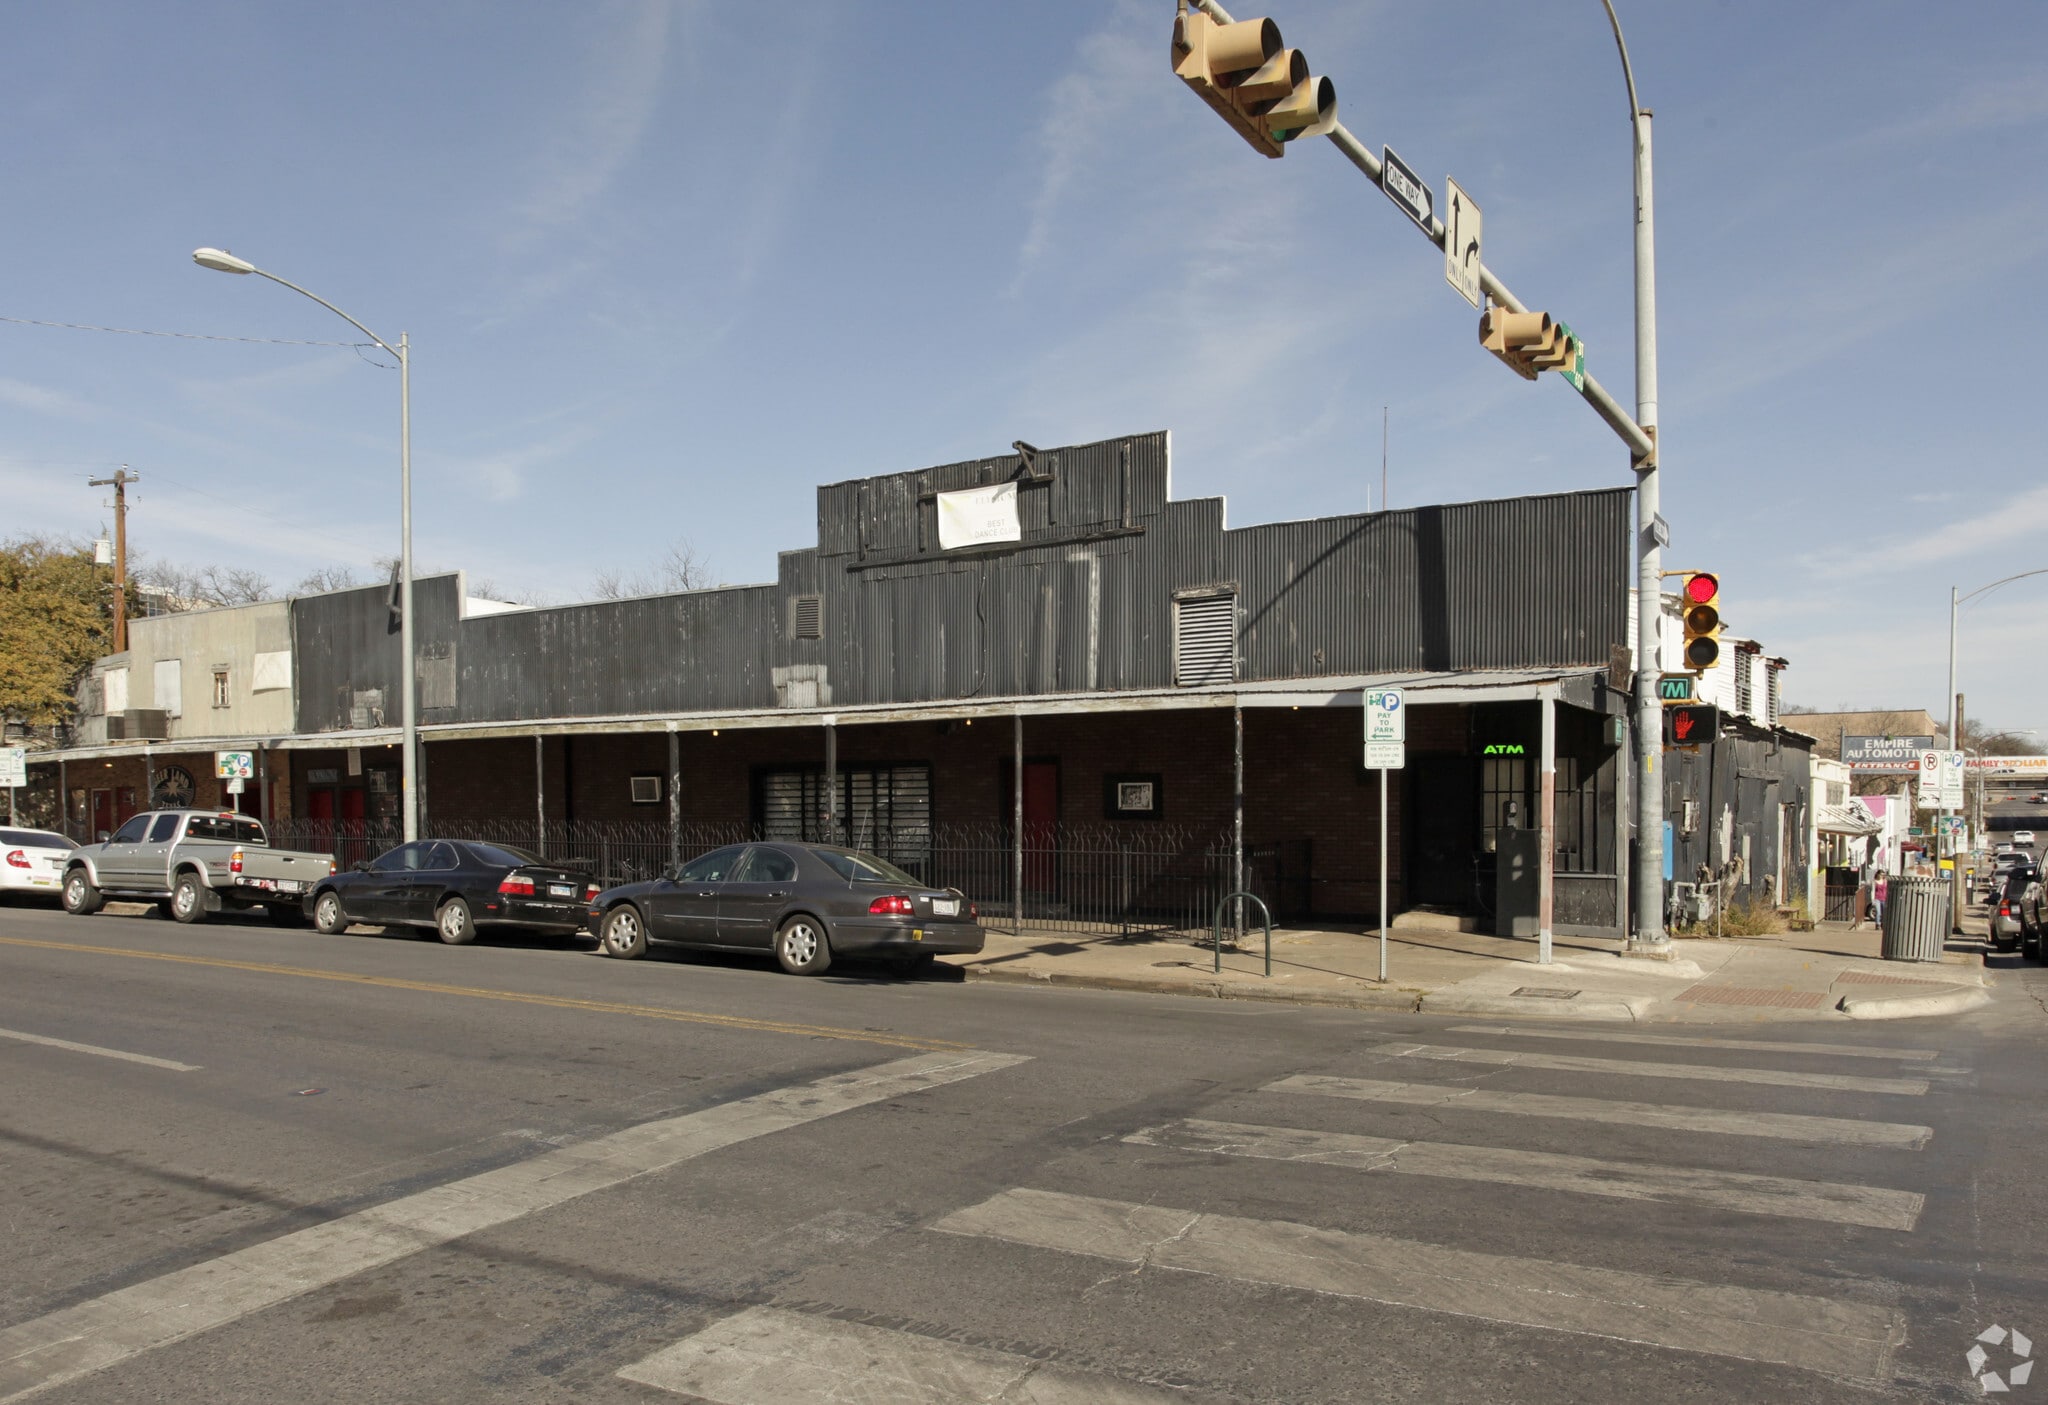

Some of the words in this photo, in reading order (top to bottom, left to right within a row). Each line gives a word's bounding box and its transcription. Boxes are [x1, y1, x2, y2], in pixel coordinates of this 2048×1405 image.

[1389, 165, 1404, 193] ONE
[1405, 180, 1420, 206] WAY
[1447, 258, 1462, 283] ONLY
[1464, 274, 1478, 299] ONLY
[987, 519, 1005, 528] BEST
[974, 528, 998, 538] DANCE
[999, 527, 1018, 535] CLUB
[1661, 682, 1685, 698] TM
[1385, 695, 1397, 710] P
[1483, 744, 1525, 754] ATM
[1864, 738, 1914, 749] EMPIRE
[1846, 748, 1921, 759] AUTOMOTIV
[1965, 759, 1999, 768] FAMILY
